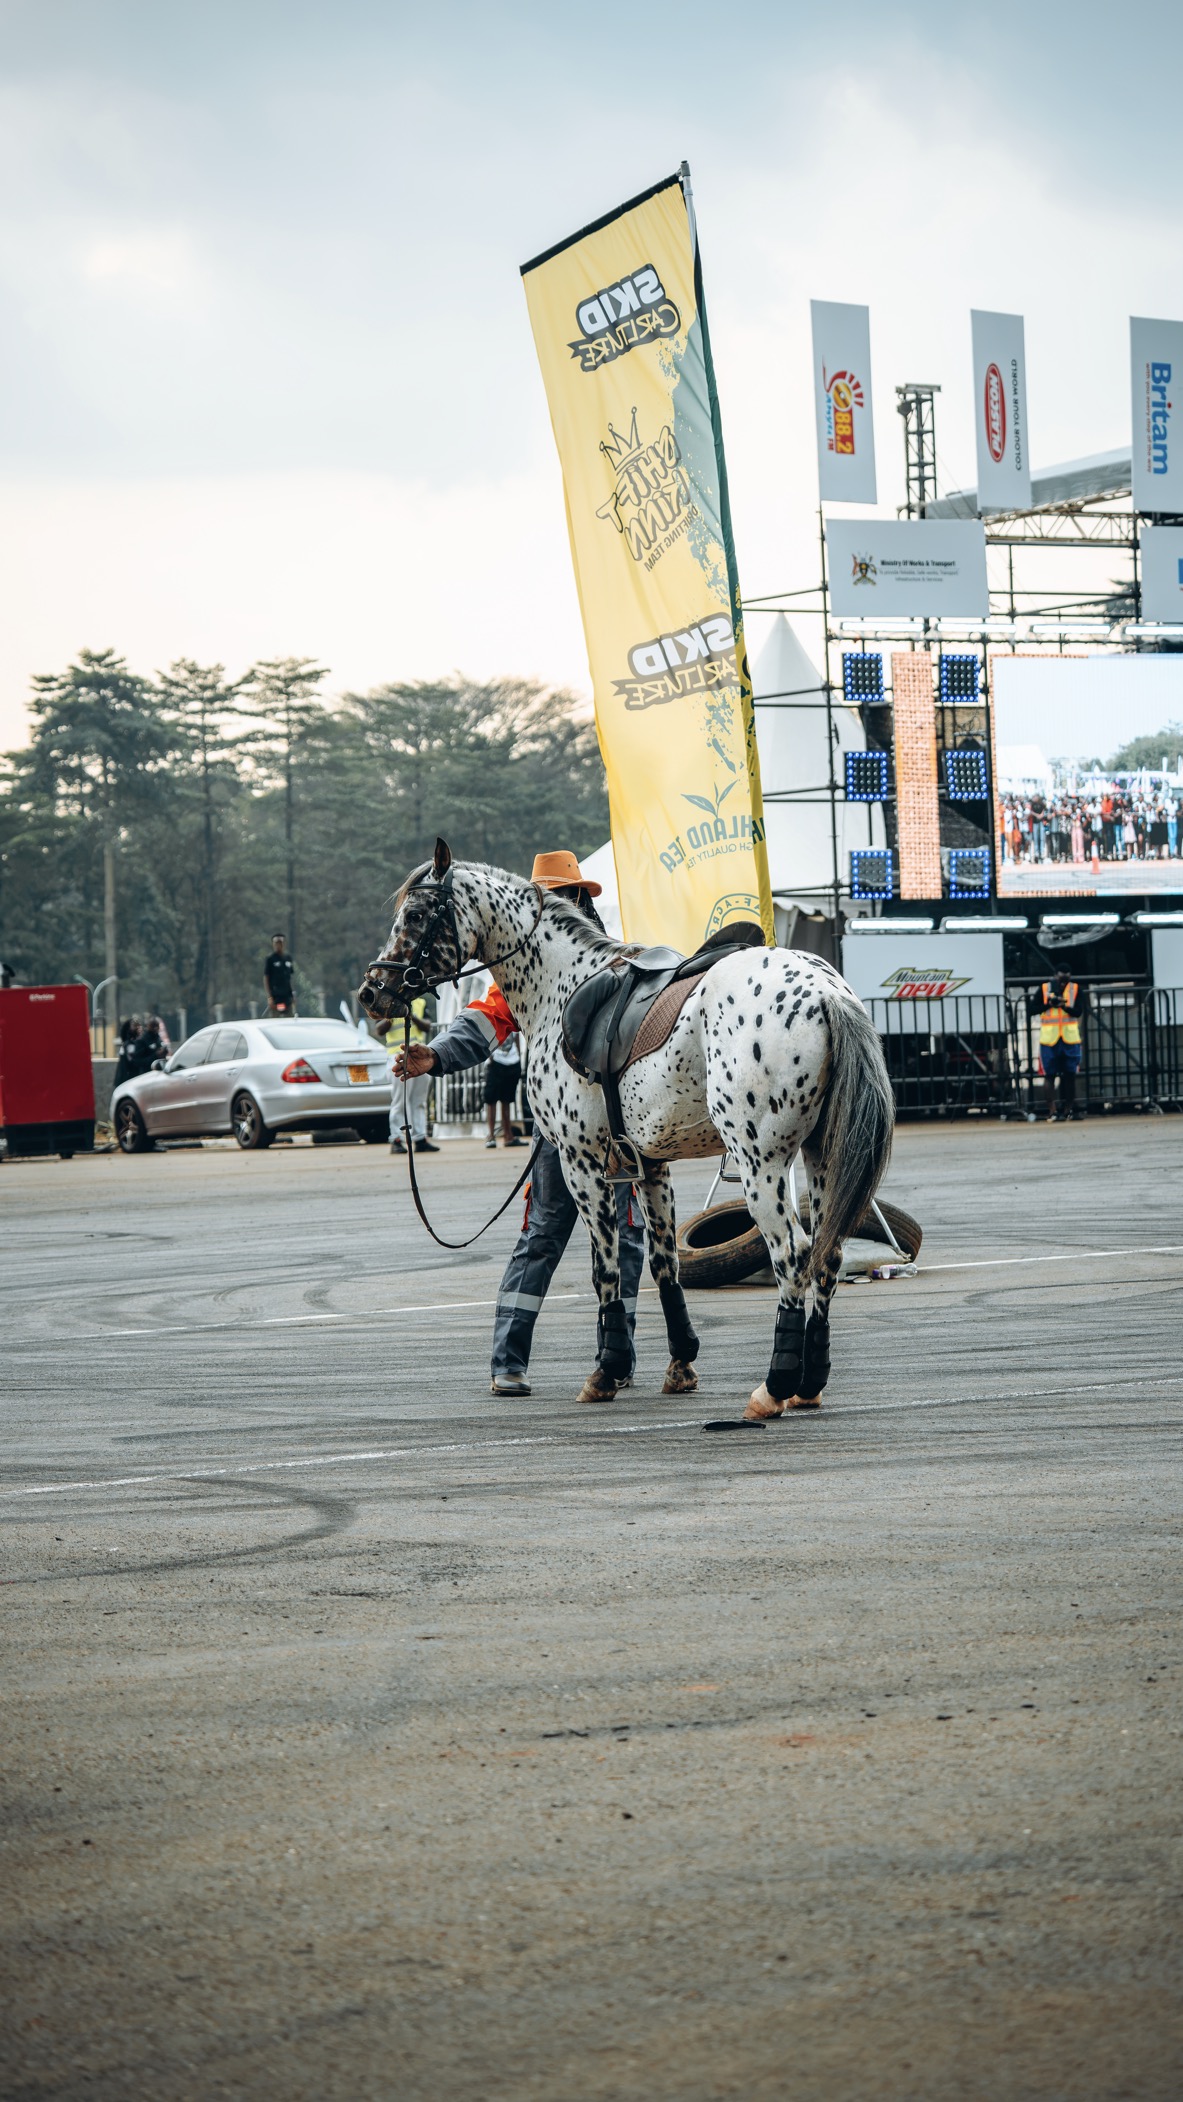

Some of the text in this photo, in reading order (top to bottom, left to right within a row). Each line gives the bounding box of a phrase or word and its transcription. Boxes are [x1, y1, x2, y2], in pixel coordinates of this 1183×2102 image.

[835, 411, 854, 453] 88.2
[989, 372, 1003, 454] PLASCON
[1010, 358, 1022, 471] COLOUR YOUR WORLD
[1151, 361, 1173, 475] Britam
[891, 971, 946, 983] Mountain
